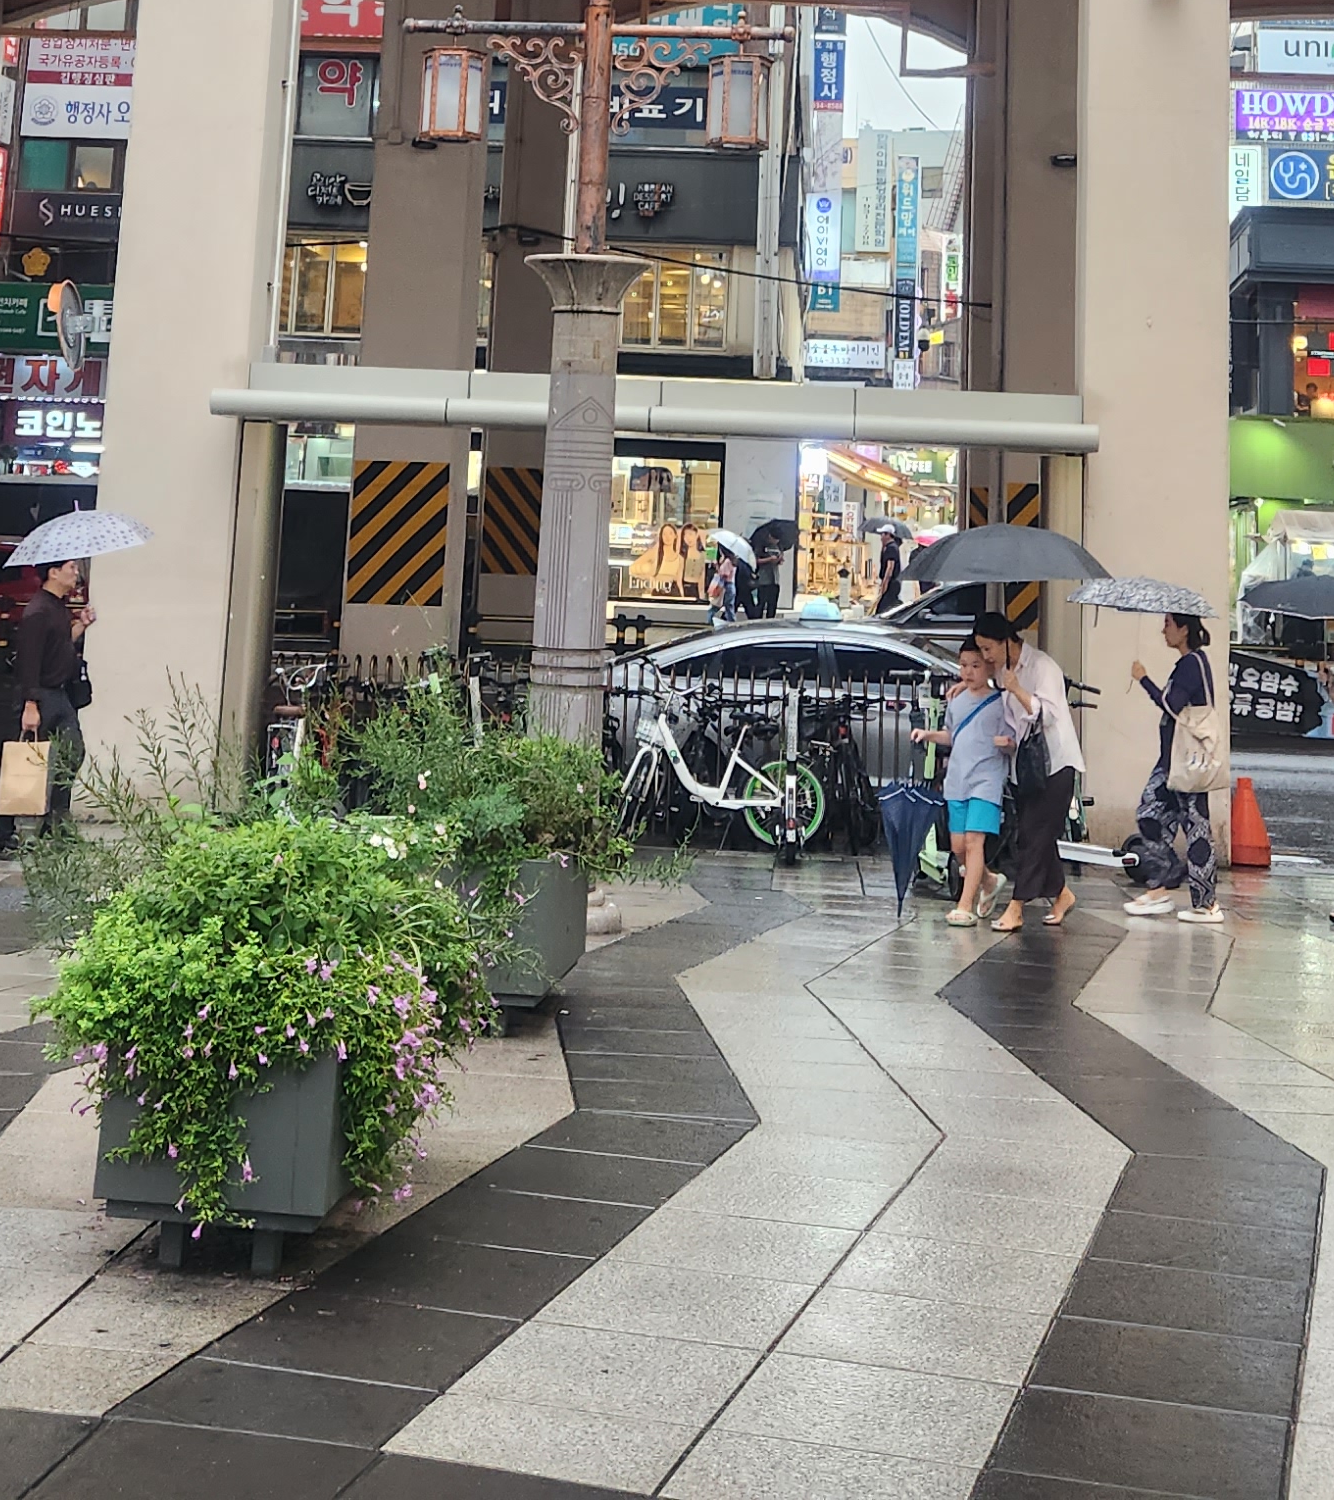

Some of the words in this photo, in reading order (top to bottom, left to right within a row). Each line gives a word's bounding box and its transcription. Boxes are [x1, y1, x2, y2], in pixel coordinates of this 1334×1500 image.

[38, 53, 122, 70] 국가유공자등록
[317, 58, 365, 109] 약
[819, 51, 839, 101] 행정사
[64, 100, 112, 126] 행정사
[1235, 153, 1251, 202] 네일담
[637, 183, 675, 193] KOREAN
[633, 192, 673, 202] DESSERT
[60, 204, 122, 218] HUES
[638, 202, 661, 211] CAFE
